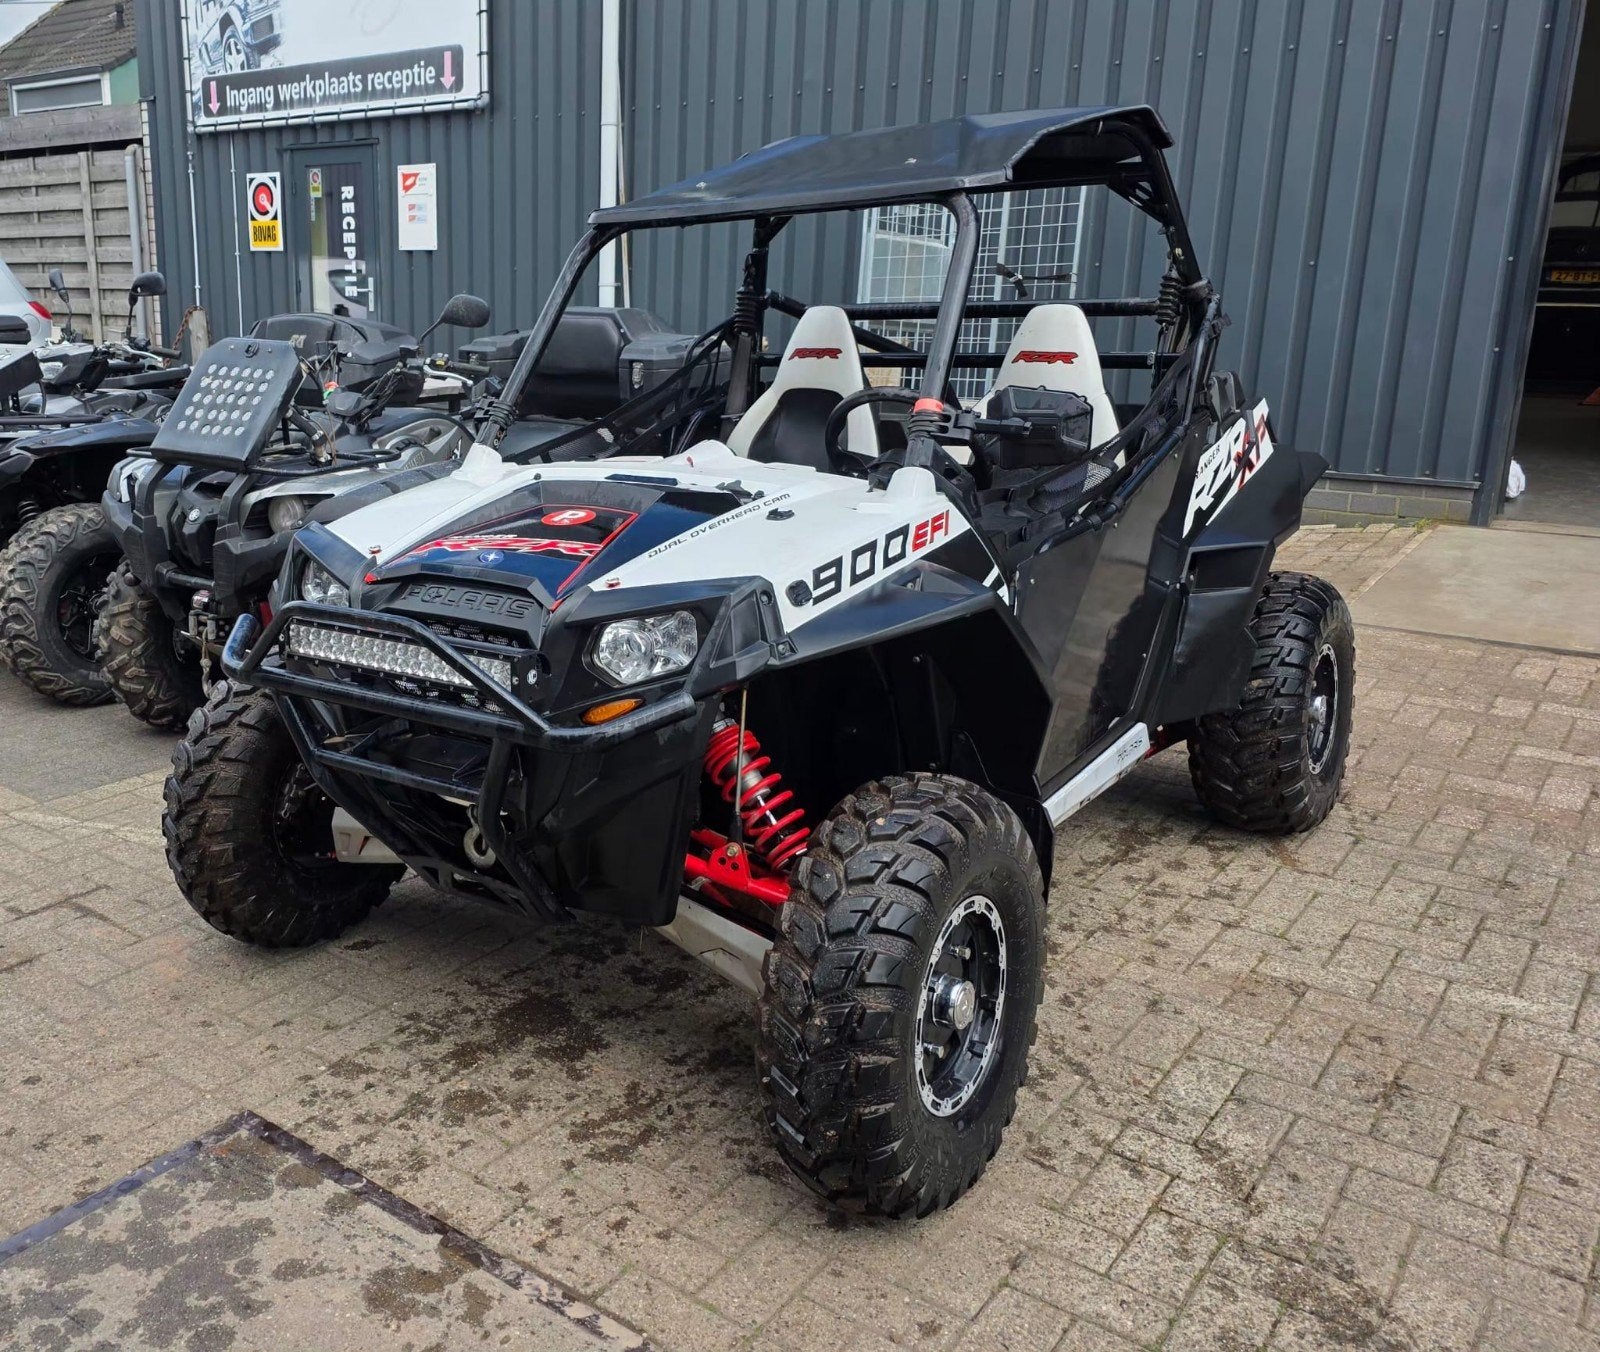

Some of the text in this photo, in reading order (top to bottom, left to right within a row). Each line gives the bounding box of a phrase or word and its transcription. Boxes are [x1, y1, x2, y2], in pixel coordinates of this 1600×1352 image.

[226, 60, 436, 111] Ingang werkplaats receptie
[253, 224, 277, 243] BOVAG
[341, 185, 358, 298] RECEPTIE
[788, 347, 843, 361] RZR
[1011, 350, 1078, 365] RZR
[648, 492, 791, 558] DUAL OVERHEAD CAM
[401, 583, 535, 620] POLARIS
